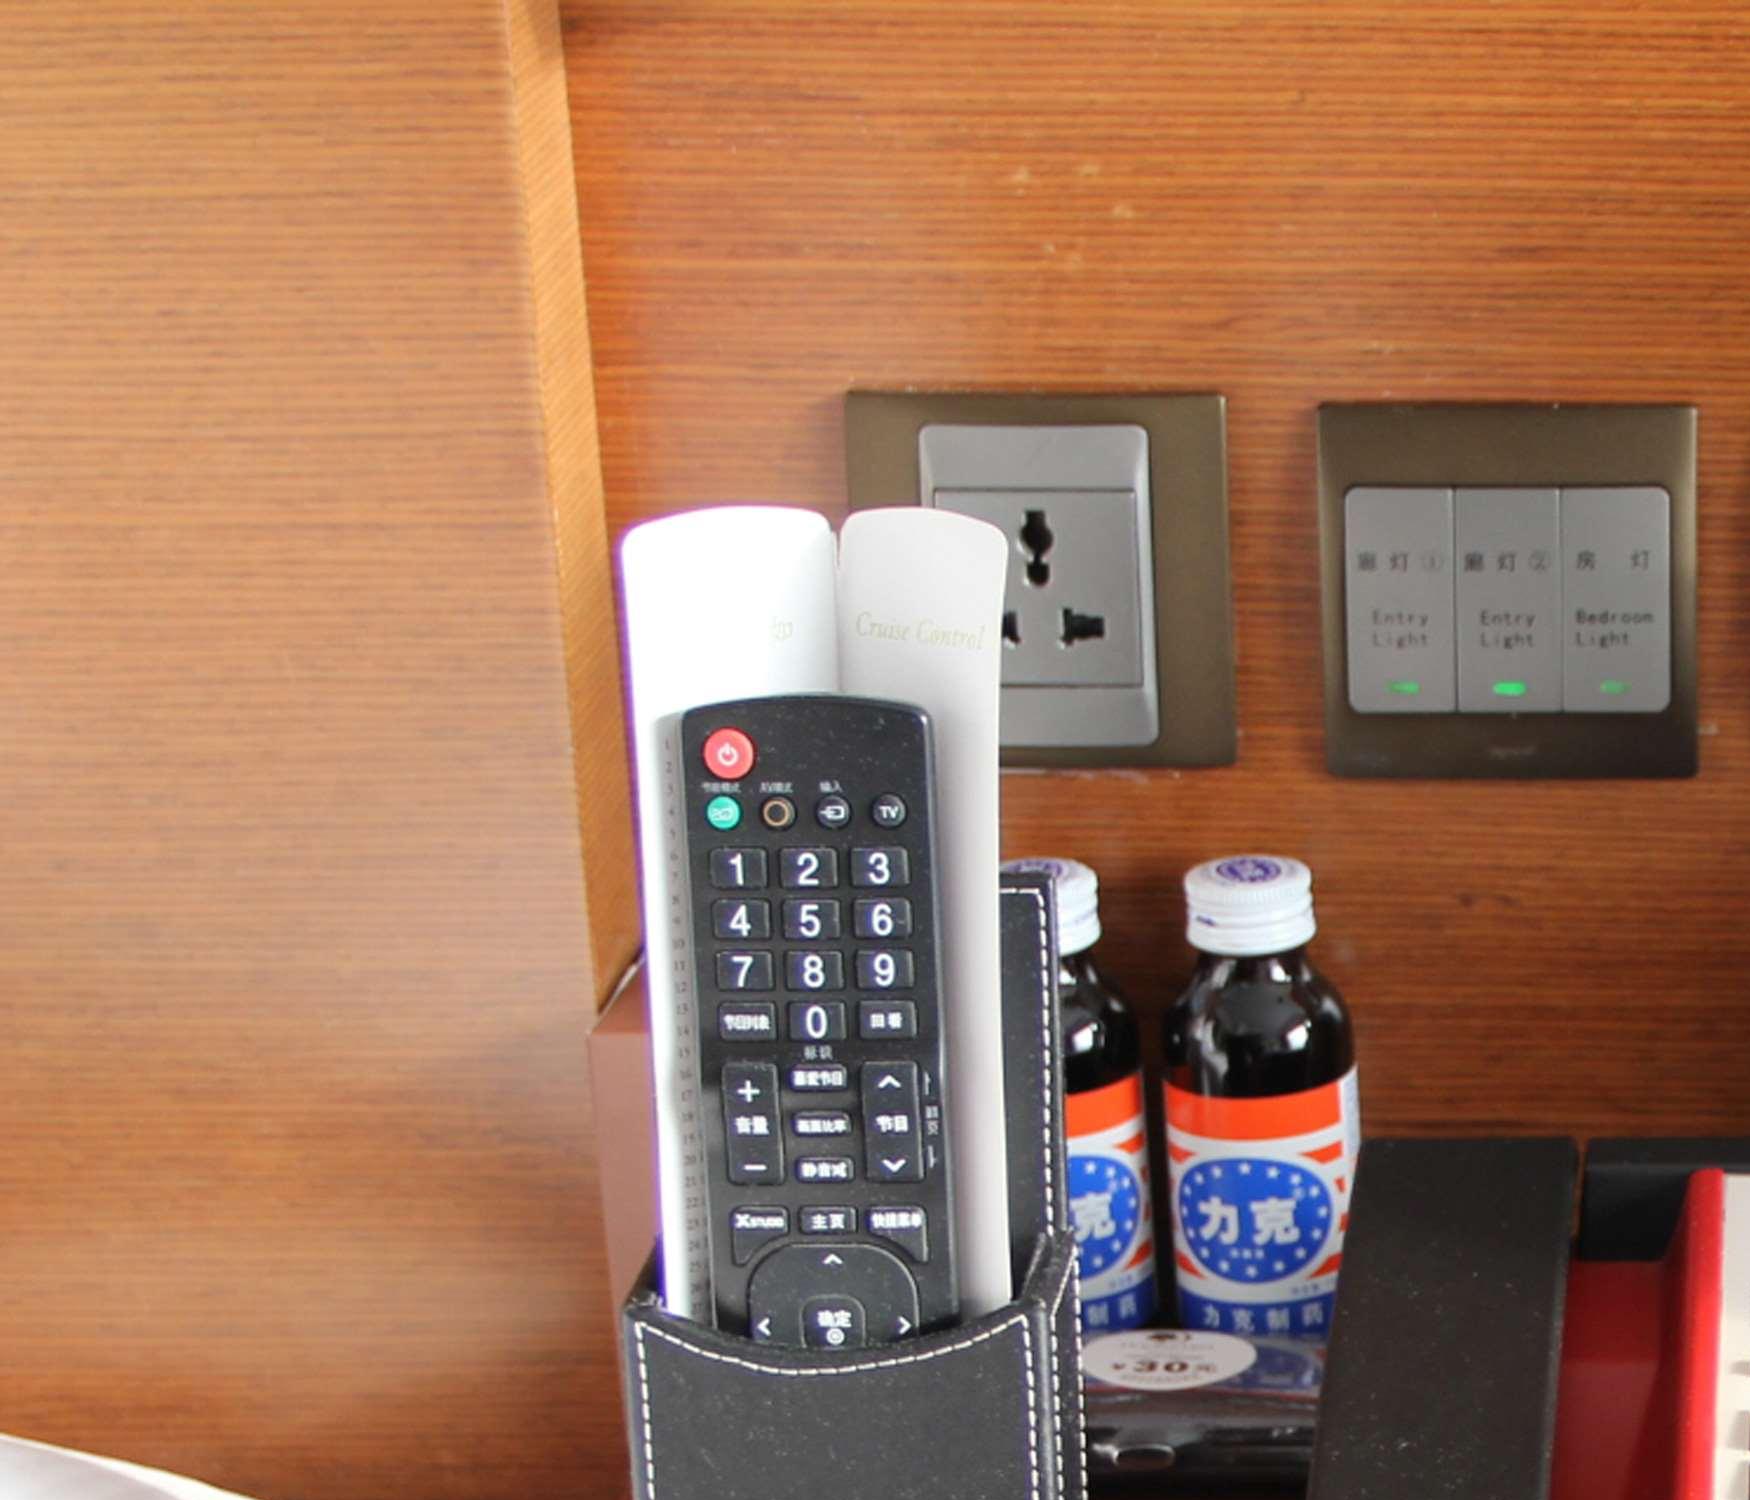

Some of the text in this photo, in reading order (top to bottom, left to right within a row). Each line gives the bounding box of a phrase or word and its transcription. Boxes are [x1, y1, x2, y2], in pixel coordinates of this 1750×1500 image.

[1372, 609, 1429, 628] Entry
[1480, 609, 1536, 628] Entry
[1575, 609, 1654, 625] Bedroom
[855, 611, 987, 650] Cruise Control
[1575, 631, 1630, 649] Light
[1372, 632, 1428, 649] Light
[1480, 632, 1535, 650] Light
[878, 805, 900, 819] TV
[729, 852, 889, 885] 1 2 3
[729, 904, 893, 937] 4 5 6
[731, 955, 896, 988] 7 8 9
[805, 1006, 827, 1039] 0
[735, 1115, 770, 1135] 音量
[875, 1114, 909, 1133] 节目
[811, 1213, 845, 1230] 主页
[1200, 1197, 1300, 1246] 力克
[817, 1310, 852, 1328] 确定
[1135, 1361, 1189, 1373] 30
